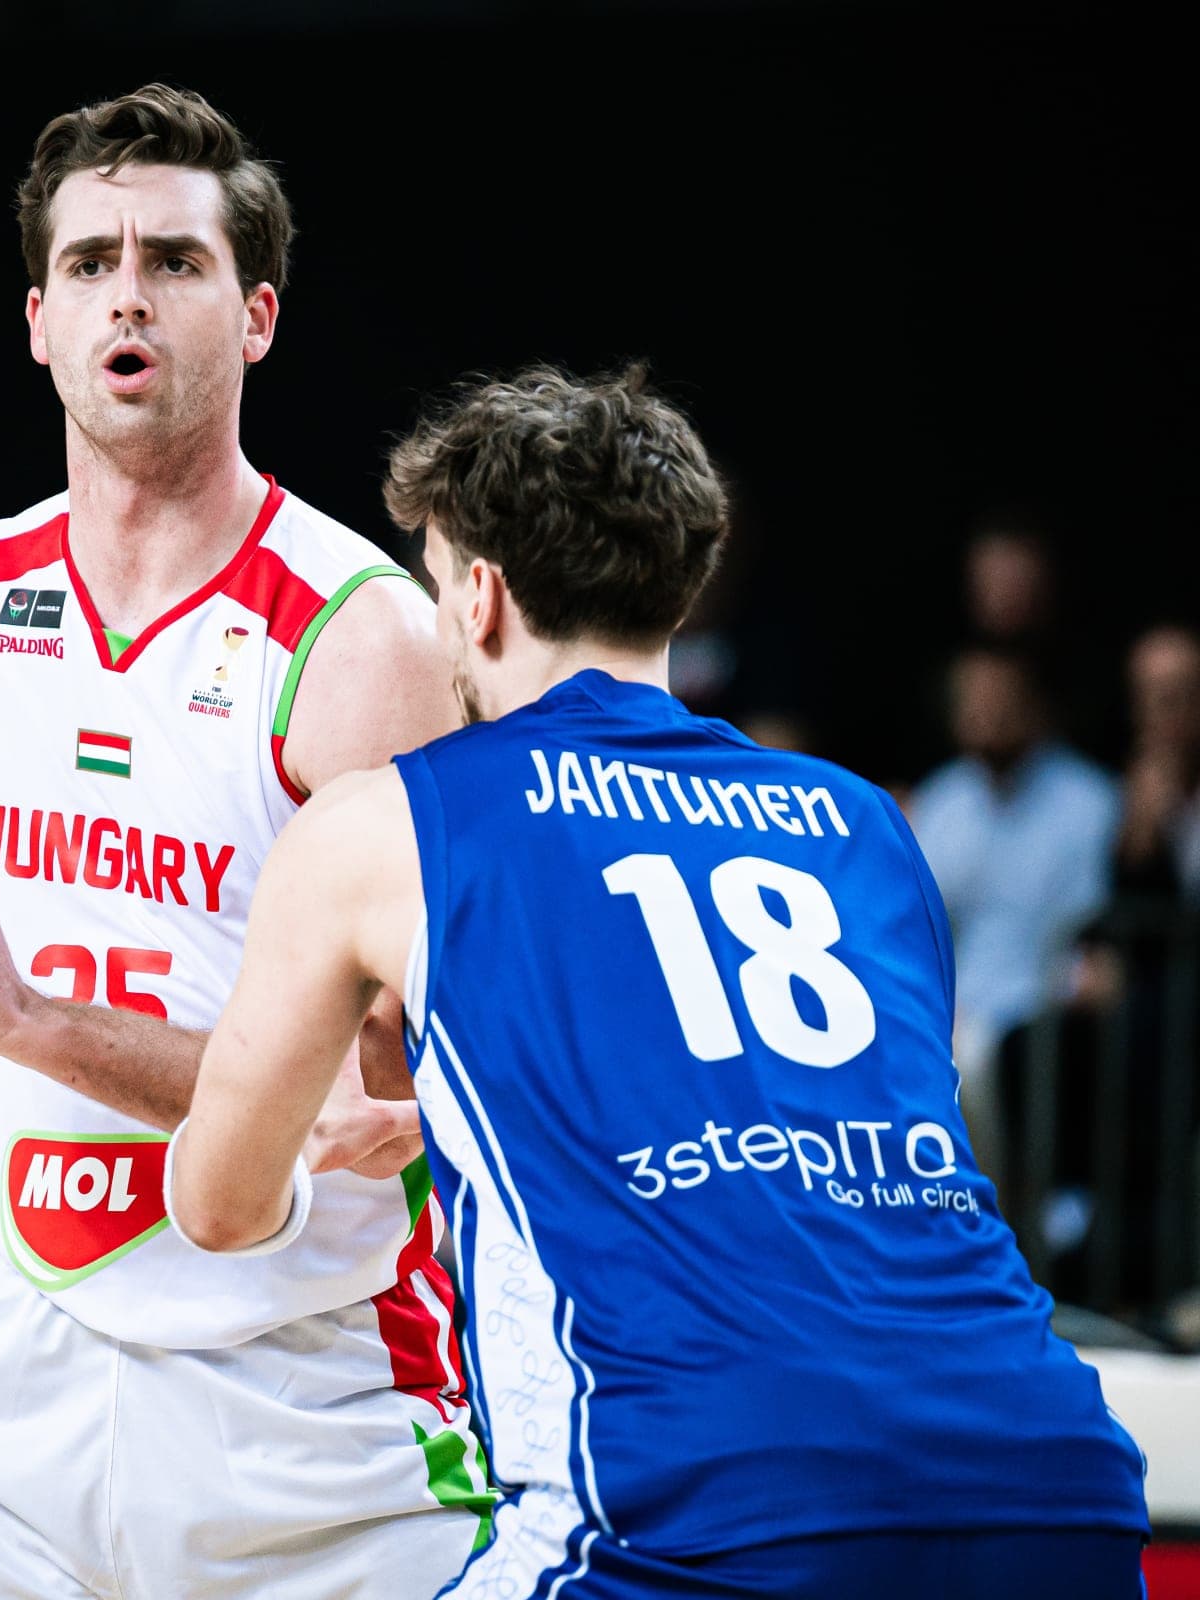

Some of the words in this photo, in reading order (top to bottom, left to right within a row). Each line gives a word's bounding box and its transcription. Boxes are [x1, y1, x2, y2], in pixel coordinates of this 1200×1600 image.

[188, 702, 230, 718] QUALIFIERS
[192, 693, 218, 706] WORLD
[219, 699, 233, 708] CUP
[602, 854, 877, 1069] 18
[19, 1153, 138, 1212] MOL
[826, 1180, 864, 1208] Go
[871, 1182, 915, 1208] full
